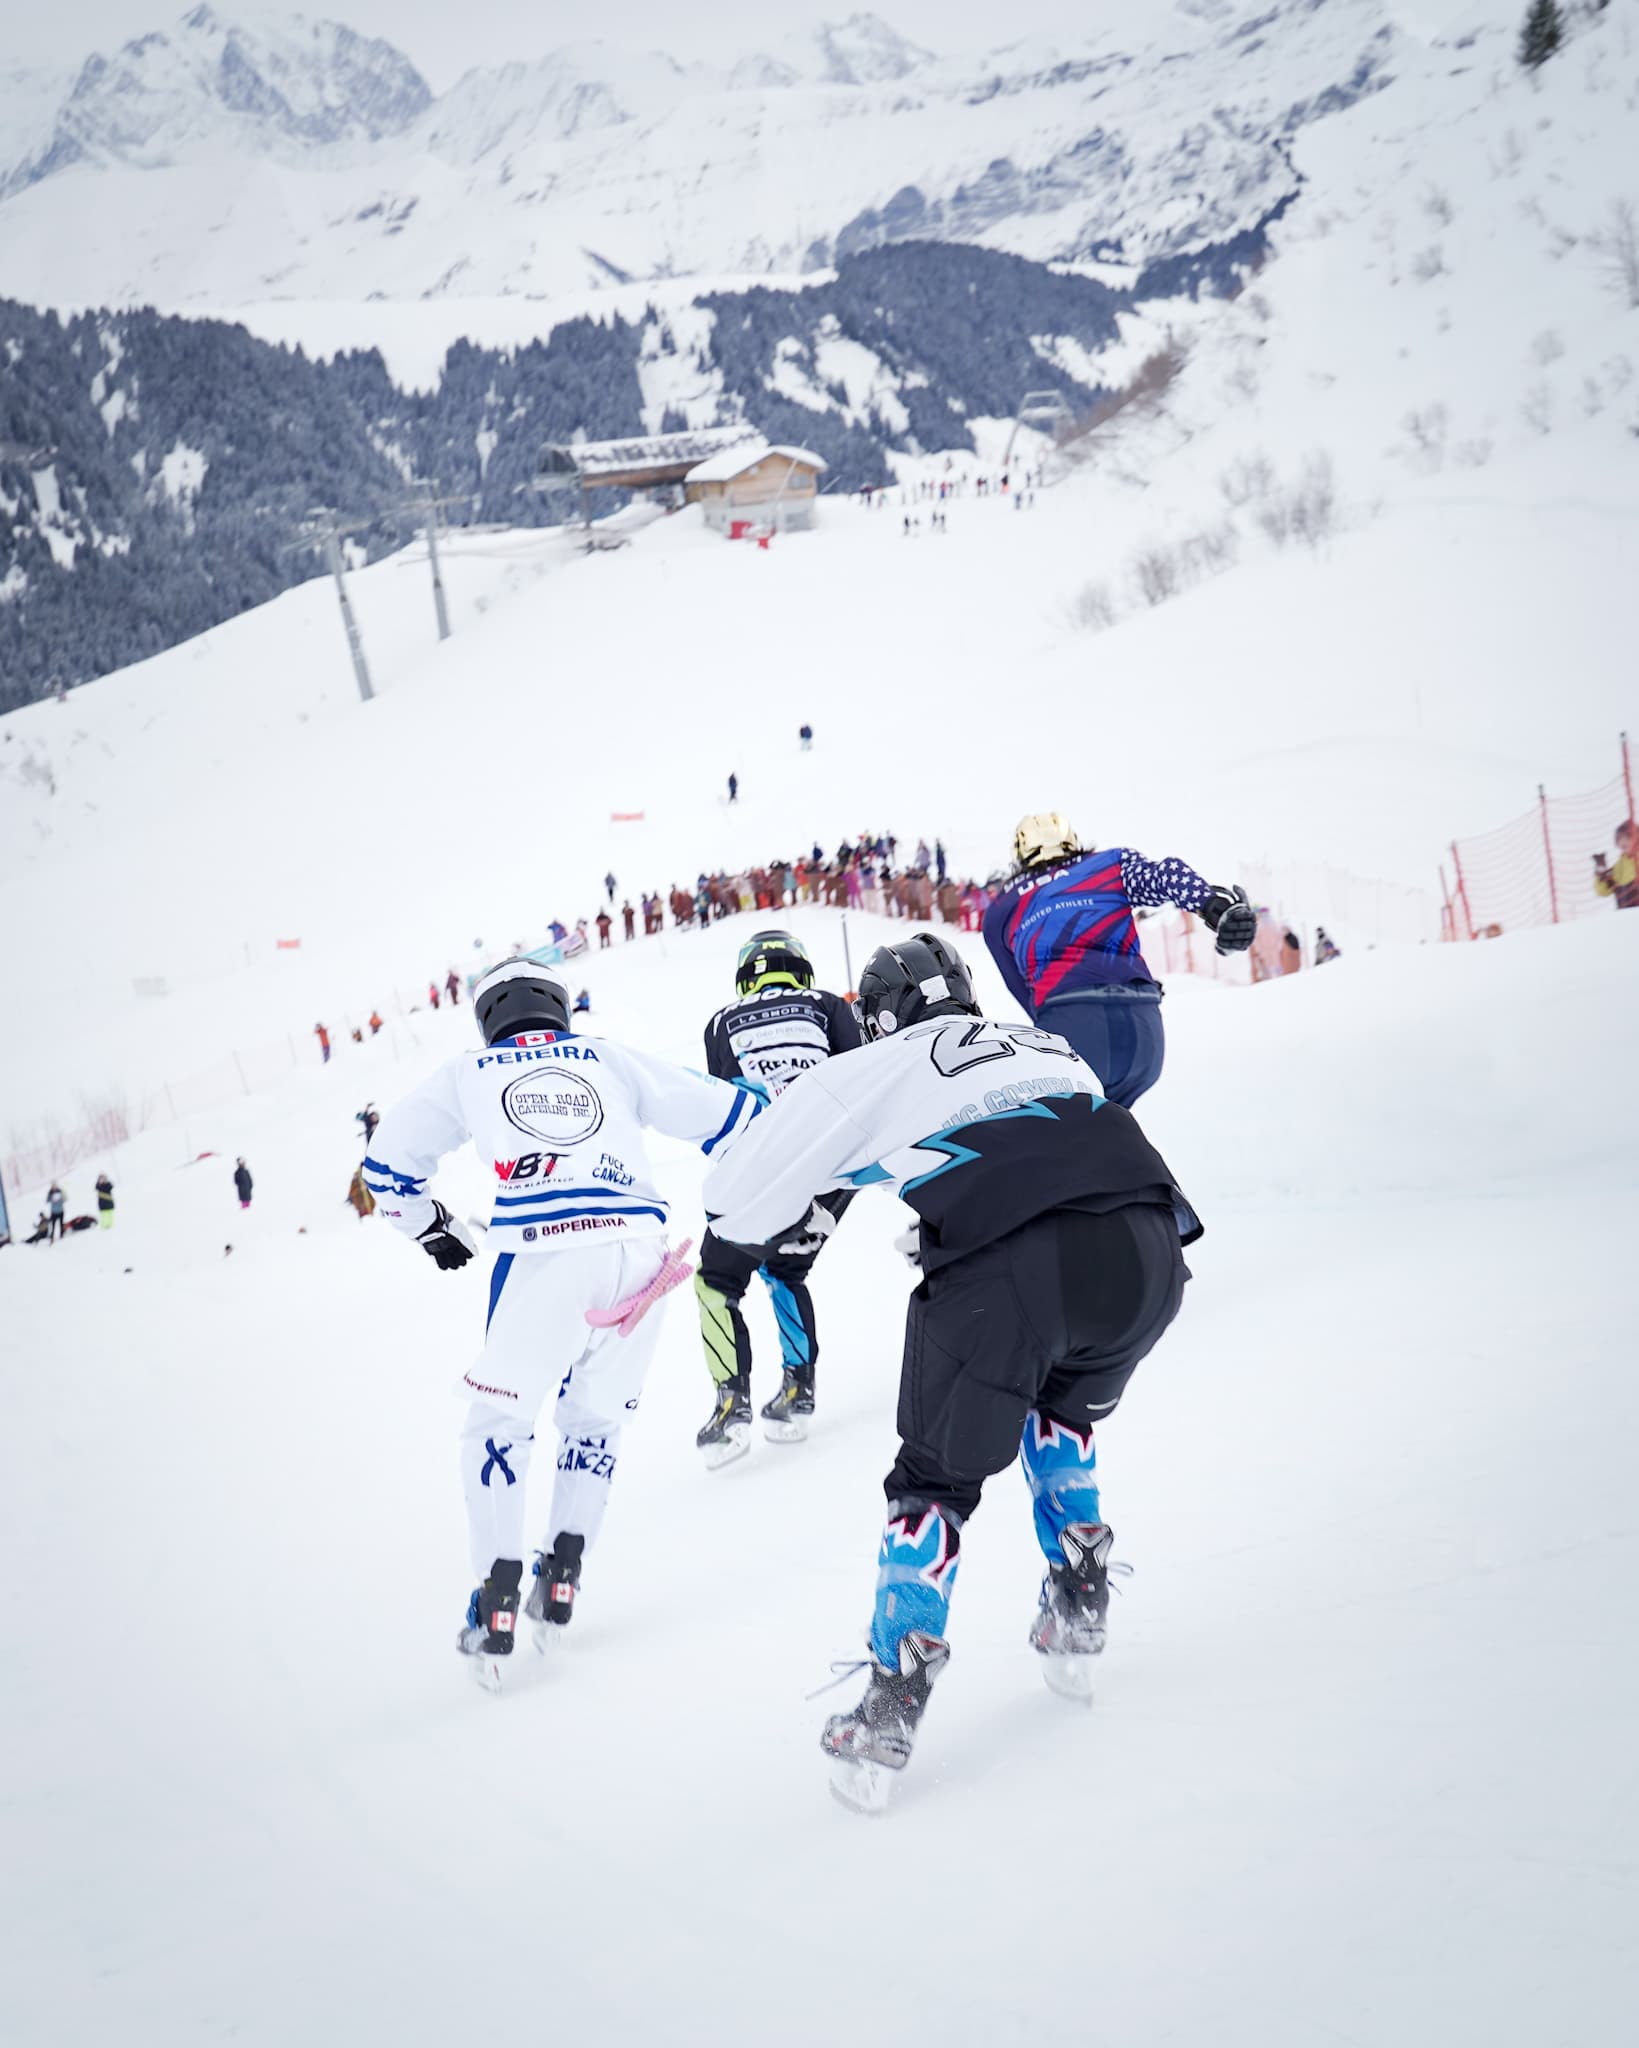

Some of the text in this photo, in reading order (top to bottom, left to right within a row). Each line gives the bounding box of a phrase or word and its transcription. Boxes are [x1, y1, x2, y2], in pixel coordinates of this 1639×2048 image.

[1017, 869, 1069, 896] USA
[1055, 898, 1094, 910] ATHLETE
[477, 1046, 600, 1069] PEREIRA
[515, 1093, 589, 1107] OPEN ROAD
[518, 1104, 568, 1116] CATERING
[600, 1153, 625, 1171] FUCK
[592, 1167, 636, 1186] CANCER
[557, 1449, 617, 1480] CANCER
